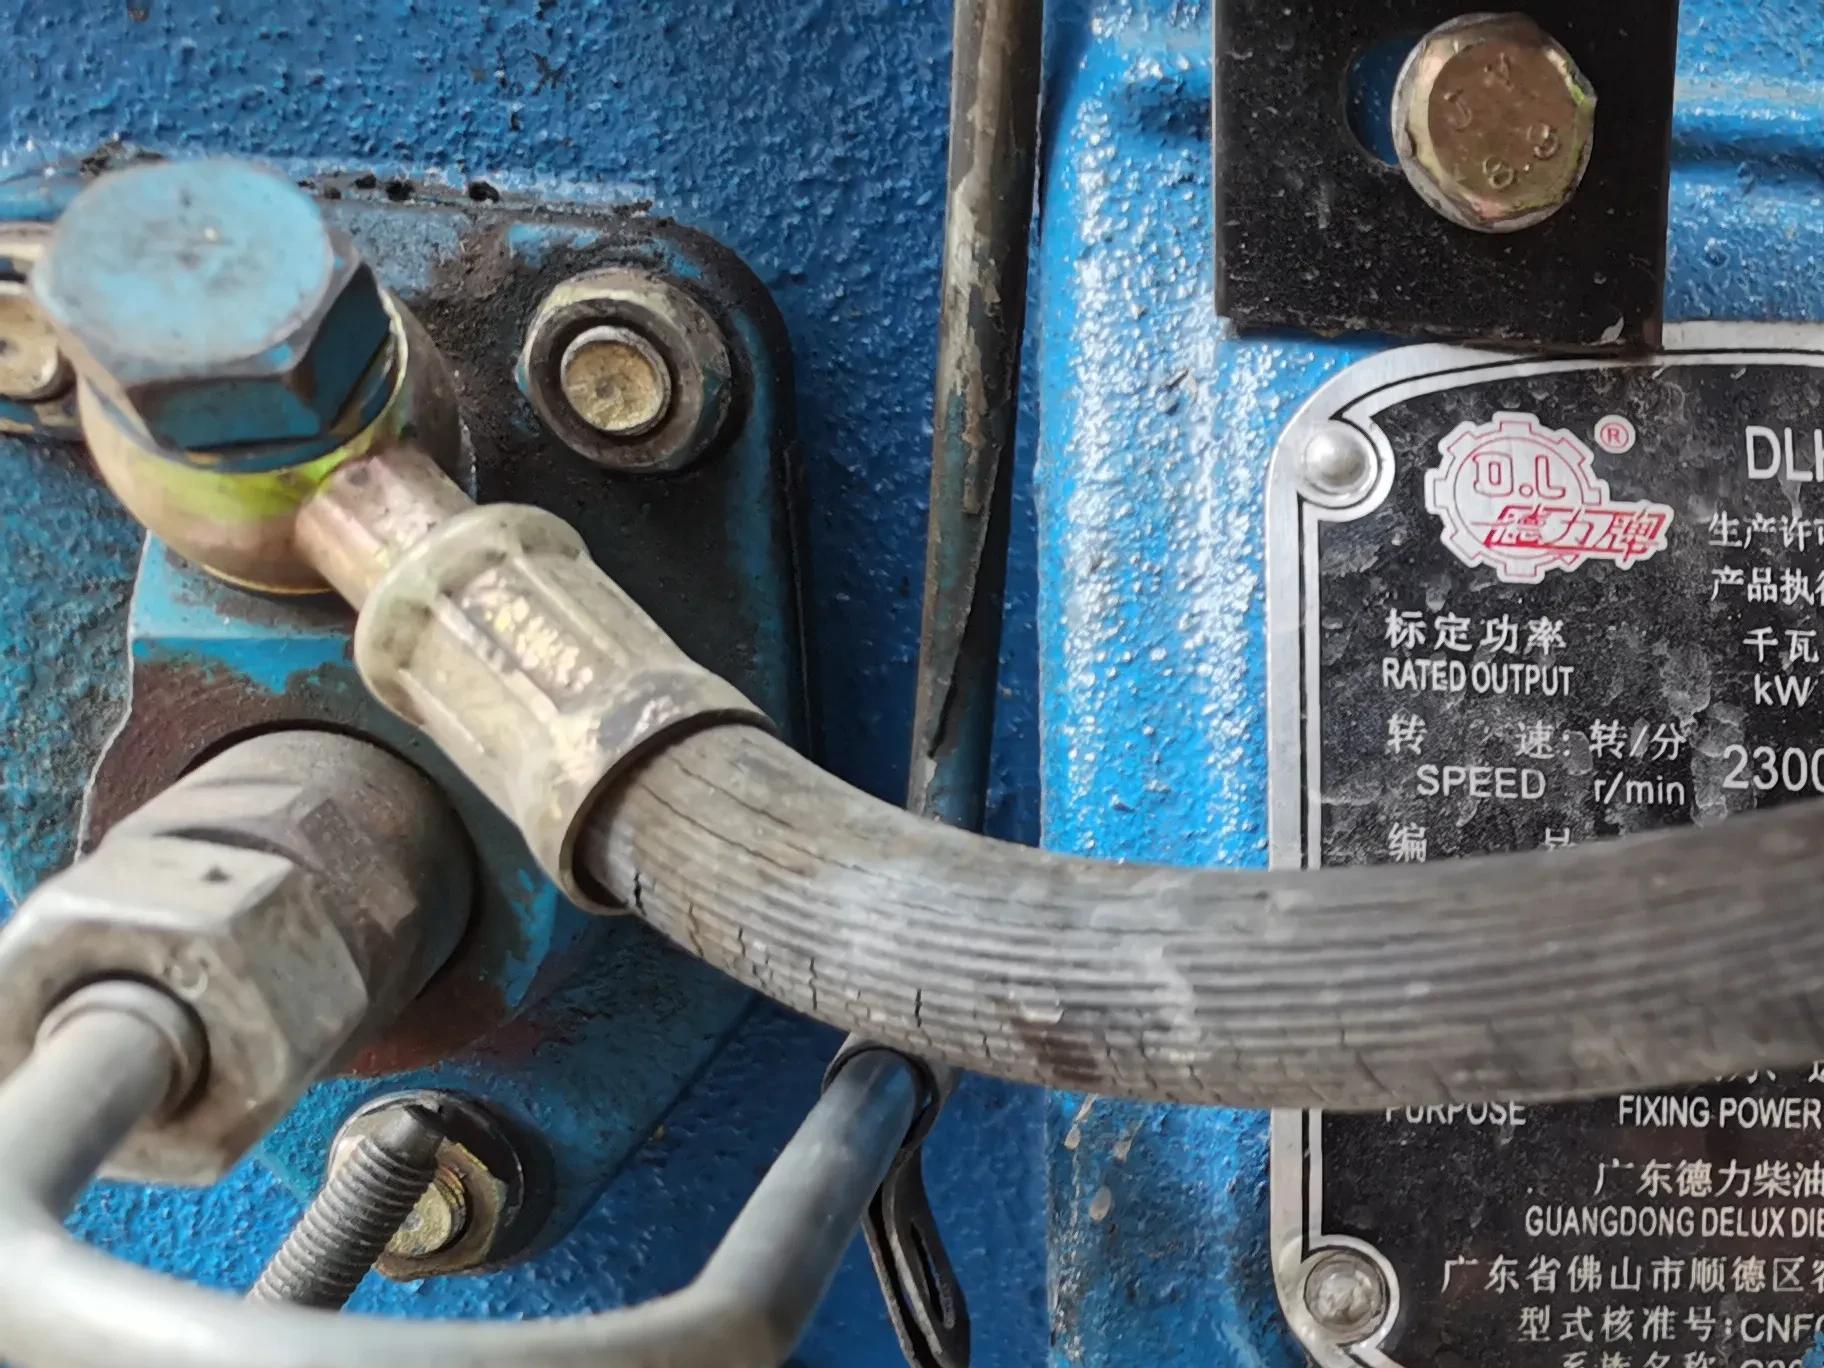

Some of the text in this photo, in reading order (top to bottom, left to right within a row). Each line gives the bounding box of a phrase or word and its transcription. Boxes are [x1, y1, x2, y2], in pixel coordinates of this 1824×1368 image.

[1385, 608, 1566, 655] 标定功率
[1743, 626, 1819, 663] 千瓦
[1382, 657, 1574, 696] RATED OUTPUT
[1754, 674, 1812, 707] kW
[1589, 719, 1686, 760] 转/分
[1417, 765, 1685, 805] SPEED r/min
[1618, 1095, 1709, 1128] FIXING
[1525, 1205, 1695, 1238] GUANGDONG
[1702, 1206, 1785, 1239] DELUX
